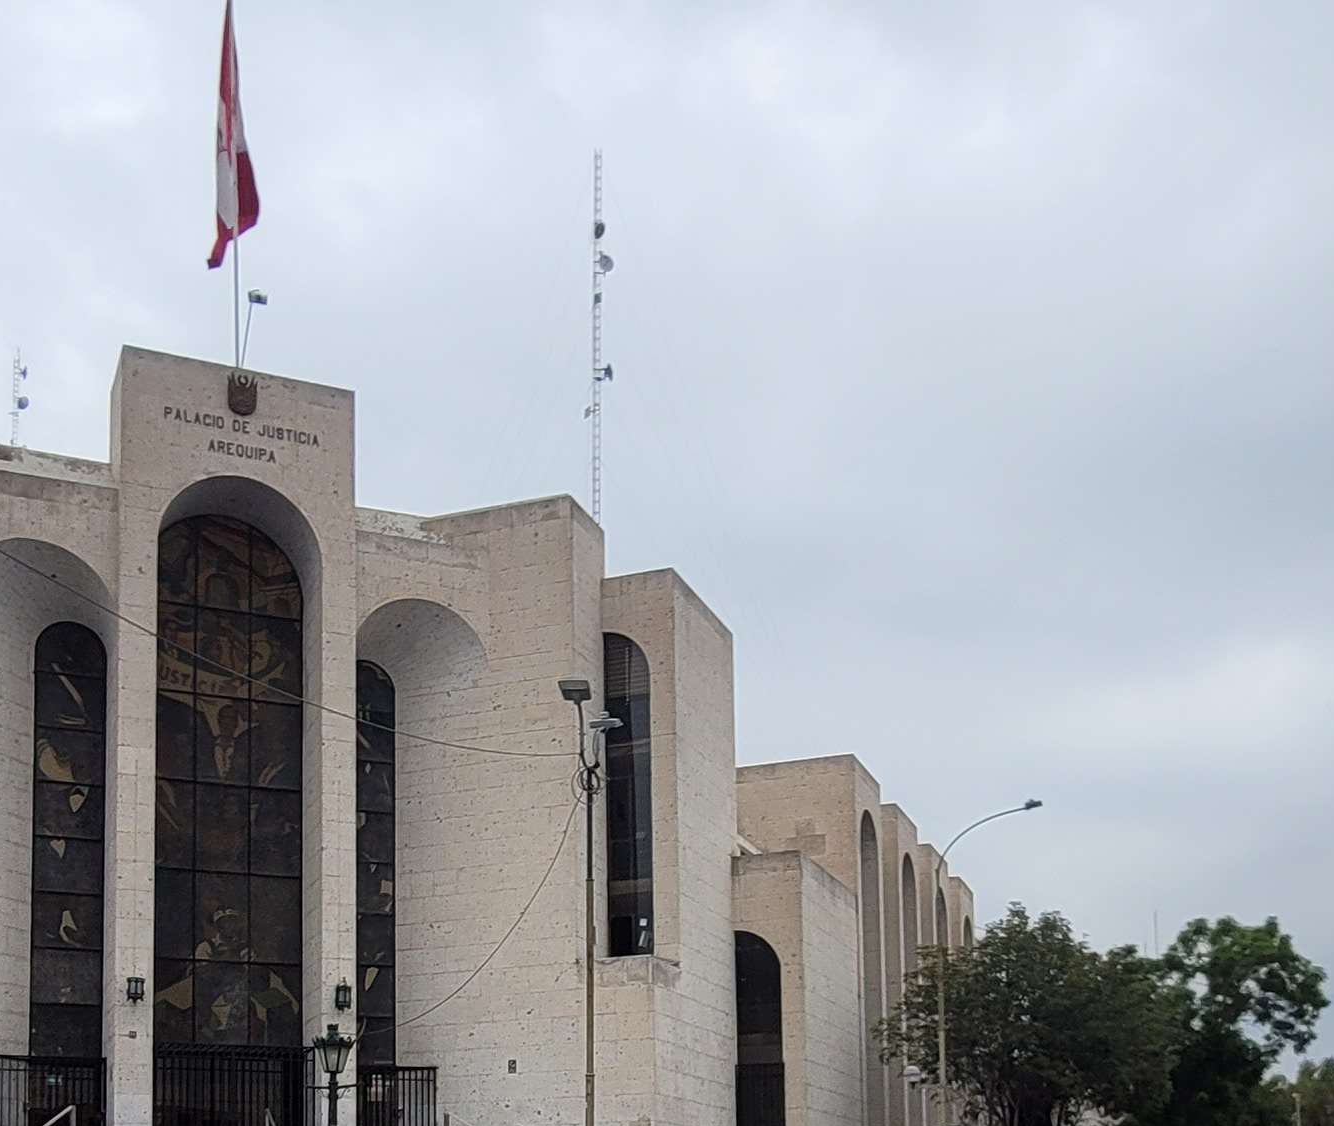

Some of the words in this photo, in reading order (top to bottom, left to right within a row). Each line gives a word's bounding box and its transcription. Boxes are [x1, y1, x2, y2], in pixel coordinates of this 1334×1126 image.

[163, 406, 224, 430] PALACIO
[232, 420, 250, 435] DE
[258, 423, 319, 448] JUSTICIA
[207, 439, 276, 464] AREQUIPA
